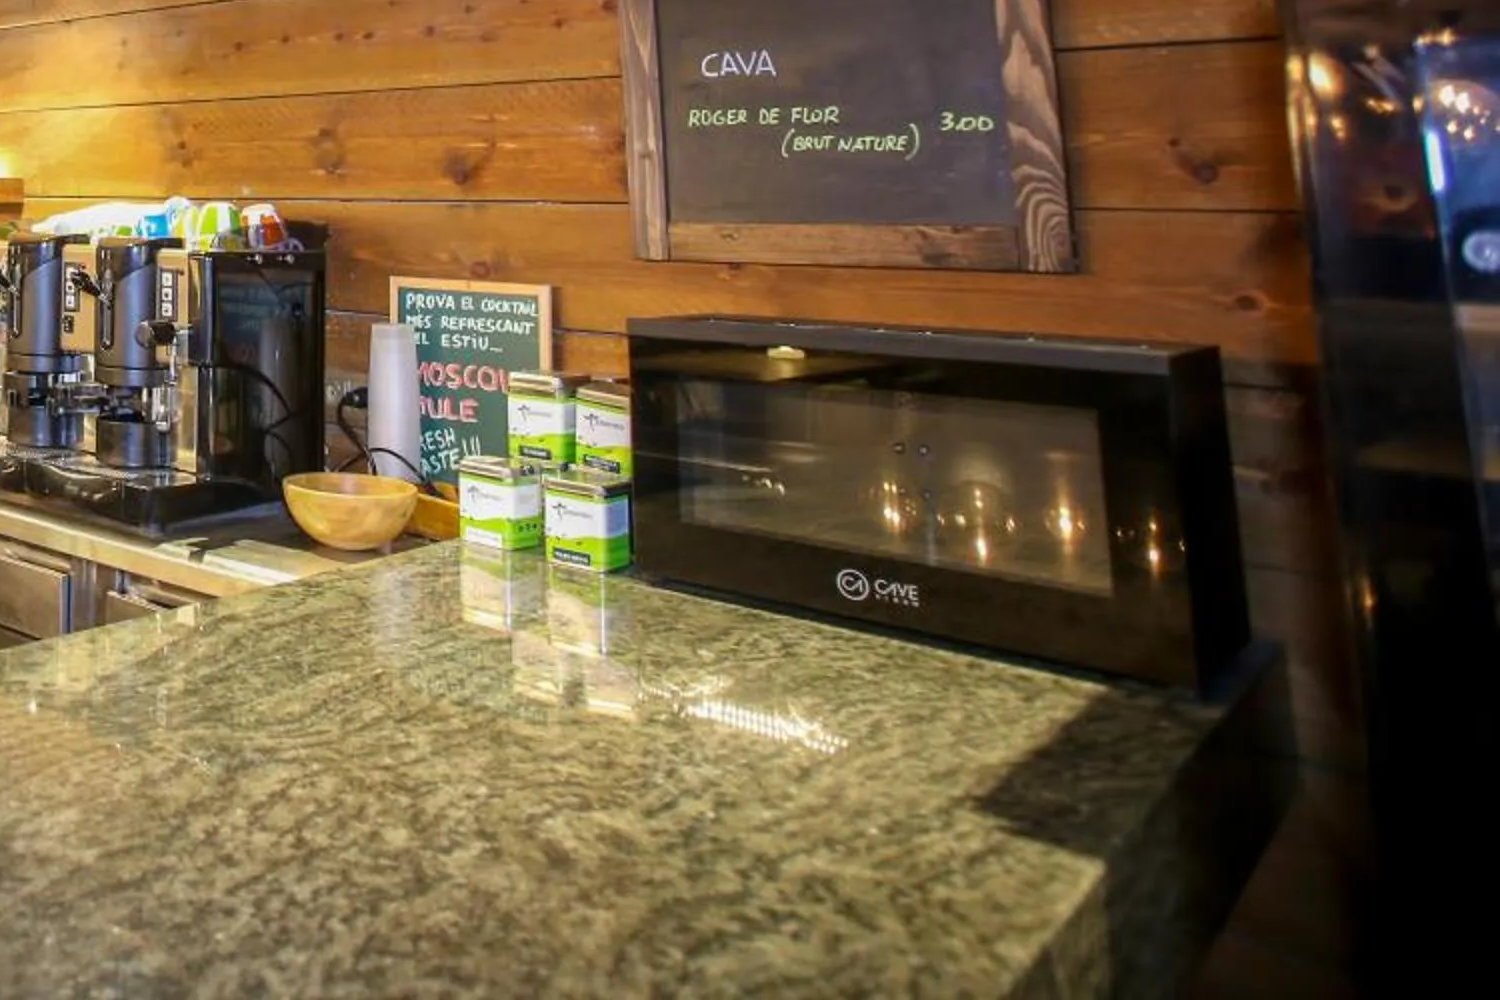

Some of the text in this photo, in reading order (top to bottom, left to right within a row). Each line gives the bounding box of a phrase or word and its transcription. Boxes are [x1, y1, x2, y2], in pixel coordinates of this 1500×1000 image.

[701, 50, 777, 78] CAVA
[689, 108, 747, 127] ROGER
[759, 108, 780, 125] DE
[791, 106, 840, 124] FLOR
[405, 293, 539, 317] PROVA EL COCKTAIL
[441, 314, 536, 335] REFRESCANT
[874, 579, 919, 601] CAVE
